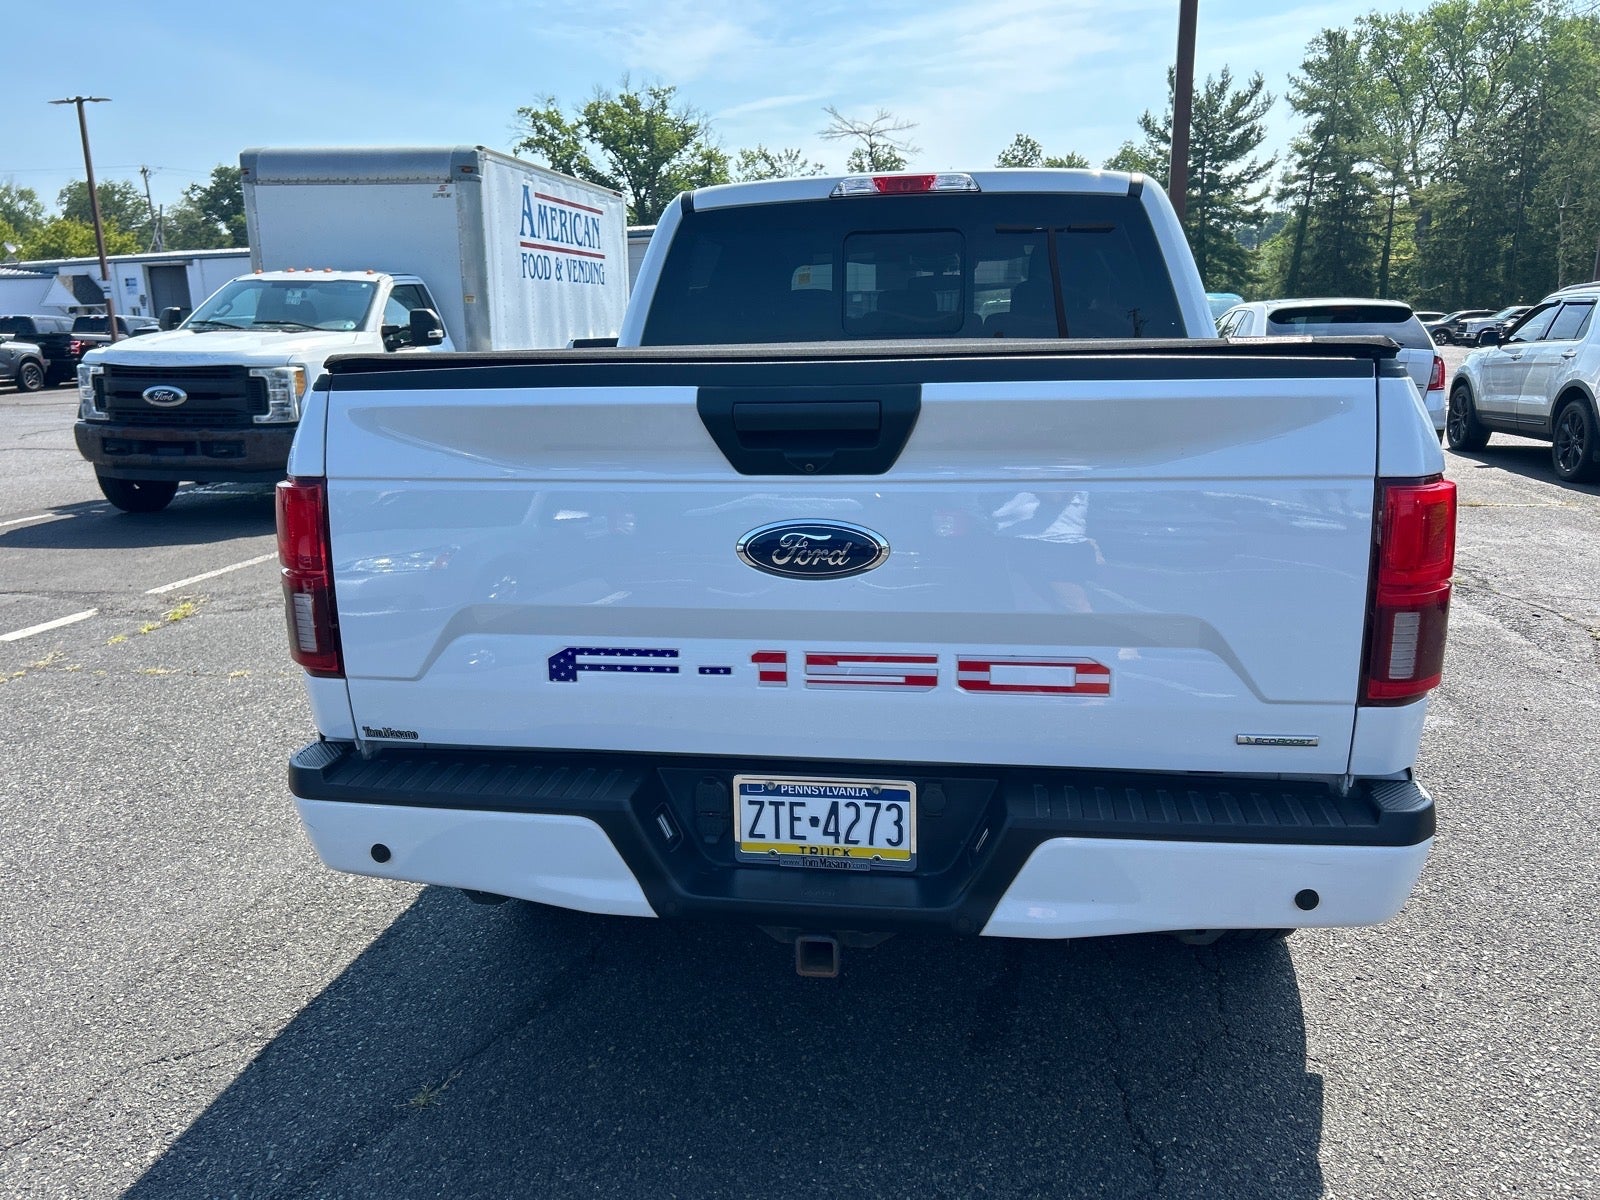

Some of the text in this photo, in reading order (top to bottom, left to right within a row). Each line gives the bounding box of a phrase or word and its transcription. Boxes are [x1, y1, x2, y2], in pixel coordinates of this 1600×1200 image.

[520, 184, 601, 250] AMERICAN
[521, 252, 606, 286] FOOD & VENDING
[153, 390, 174, 402] Ford
[771, 532, 853, 567] Ford
[548, 646, 1112, 698] F-150
[780, 784, 869, 797] PENNSYLVANIA
[798, 845, 853, 857] TRUCK
